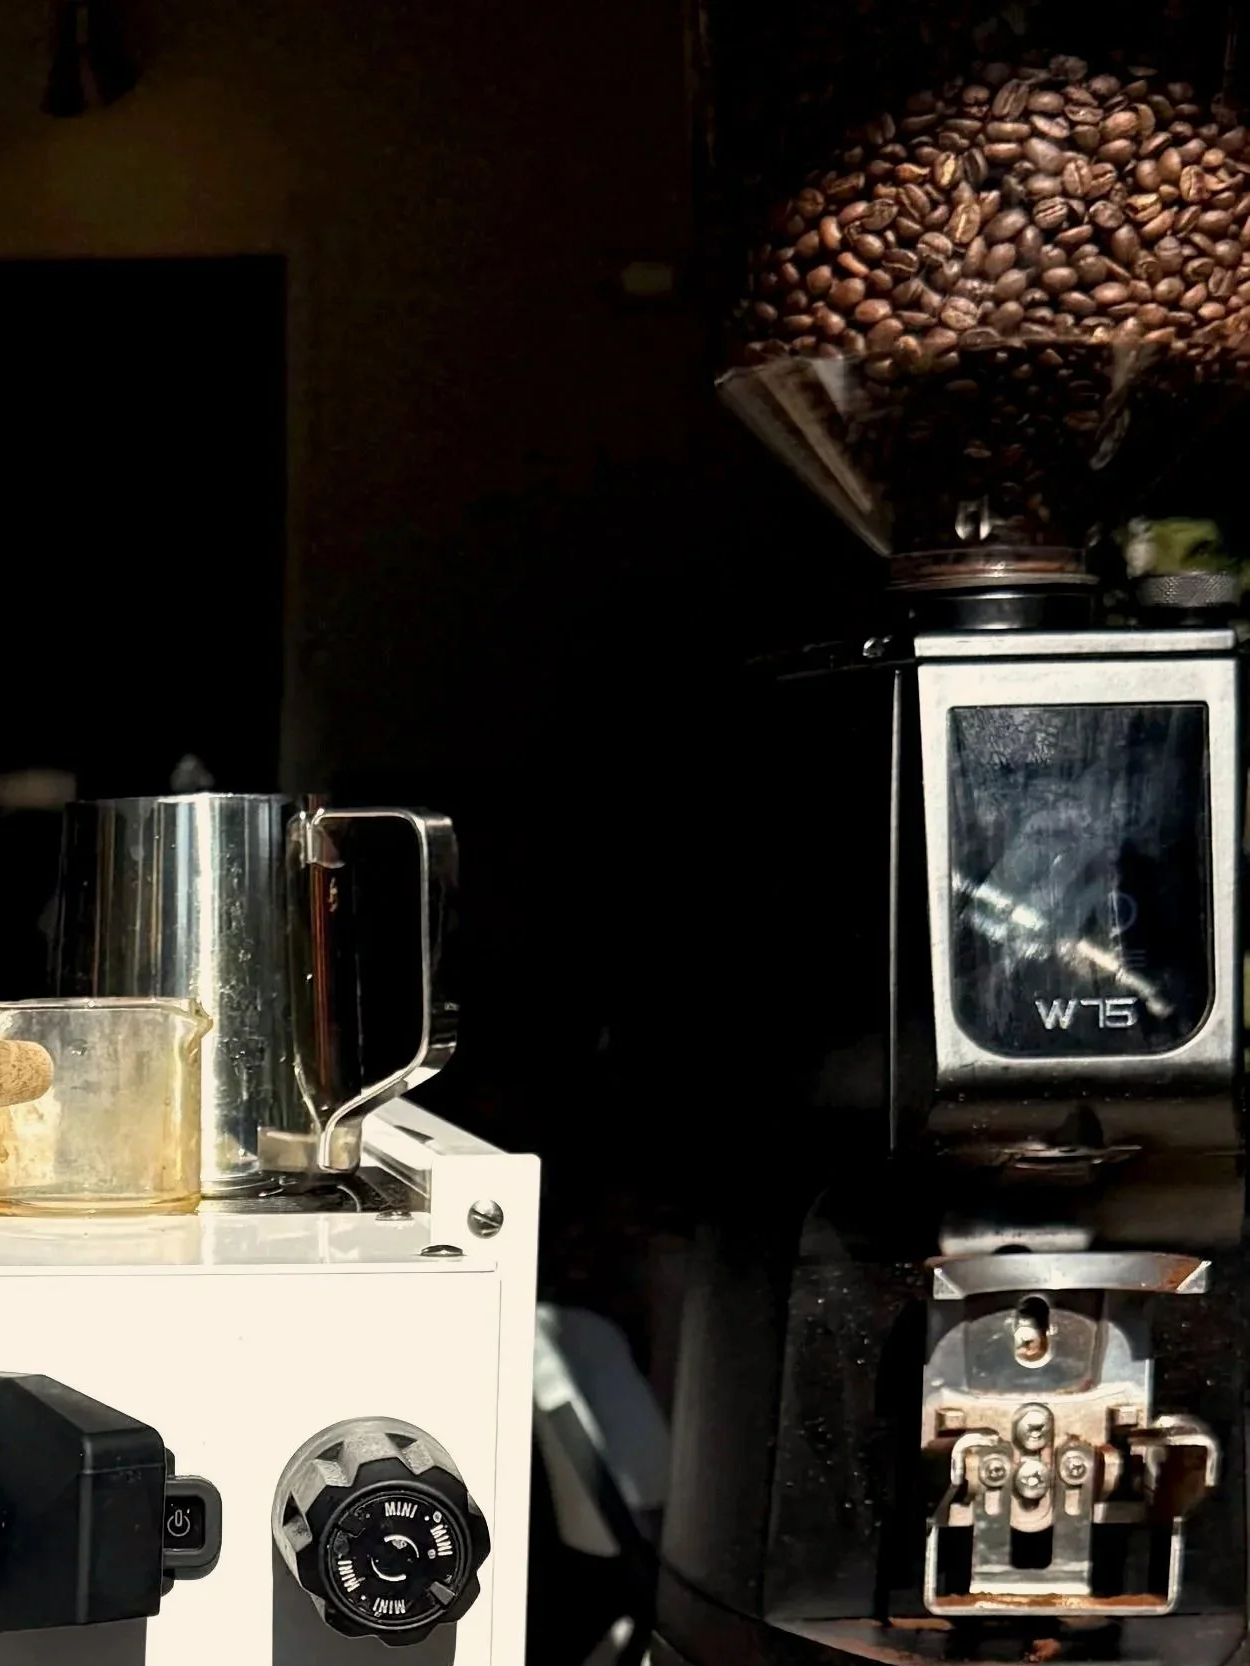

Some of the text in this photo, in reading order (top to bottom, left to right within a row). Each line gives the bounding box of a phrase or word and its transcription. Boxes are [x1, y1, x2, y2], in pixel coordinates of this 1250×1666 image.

[385, 1501, 453, 1556] MINI MINI
[337, 1560, 406, 1614] MINI MINI
